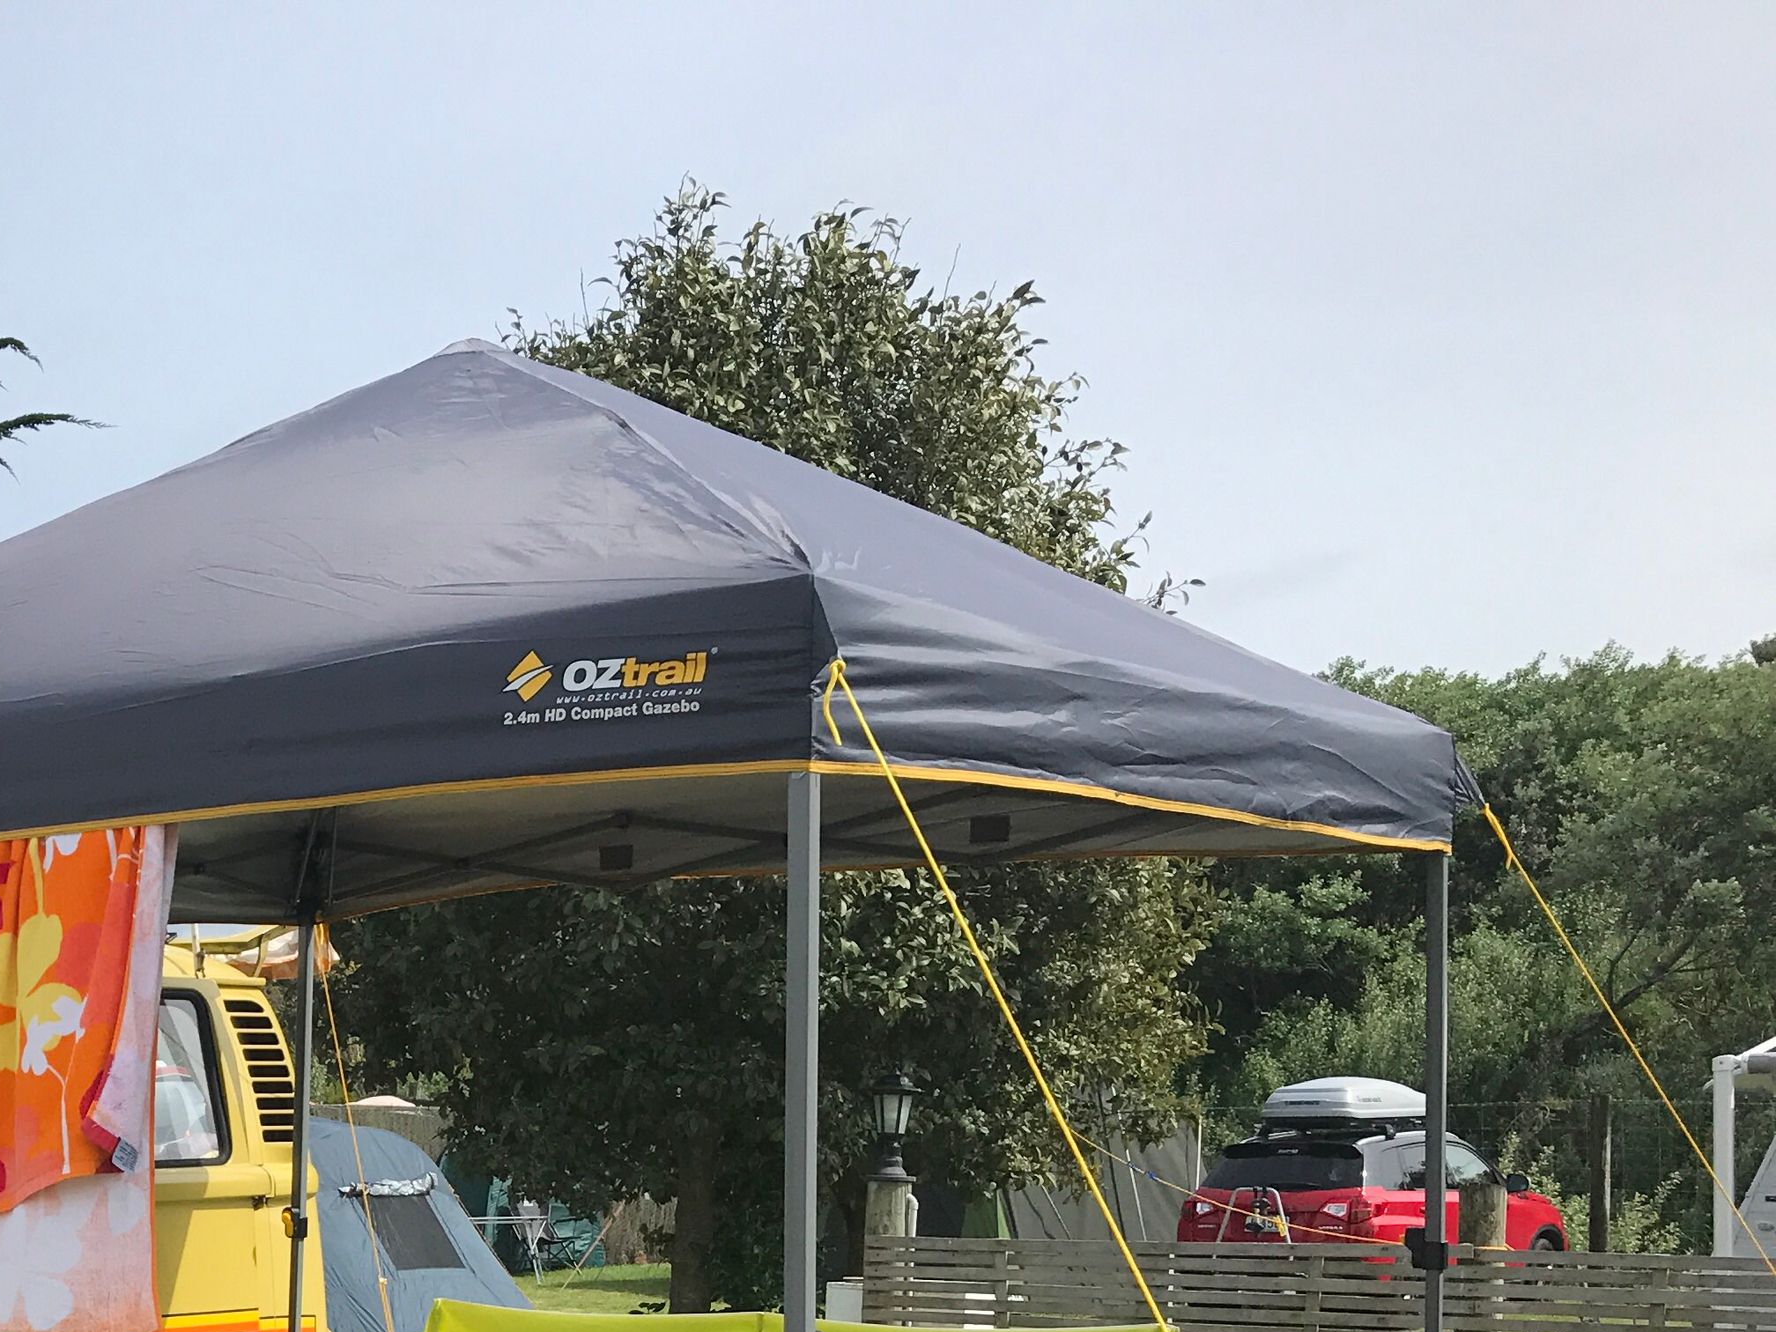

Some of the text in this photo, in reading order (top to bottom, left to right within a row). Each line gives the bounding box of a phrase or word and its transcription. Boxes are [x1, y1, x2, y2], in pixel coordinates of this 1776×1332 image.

[556, 687, 703, 704] www.oztrail.com.au
[503, 700, 700, 725] 2.4m HD Compact Gazebo
